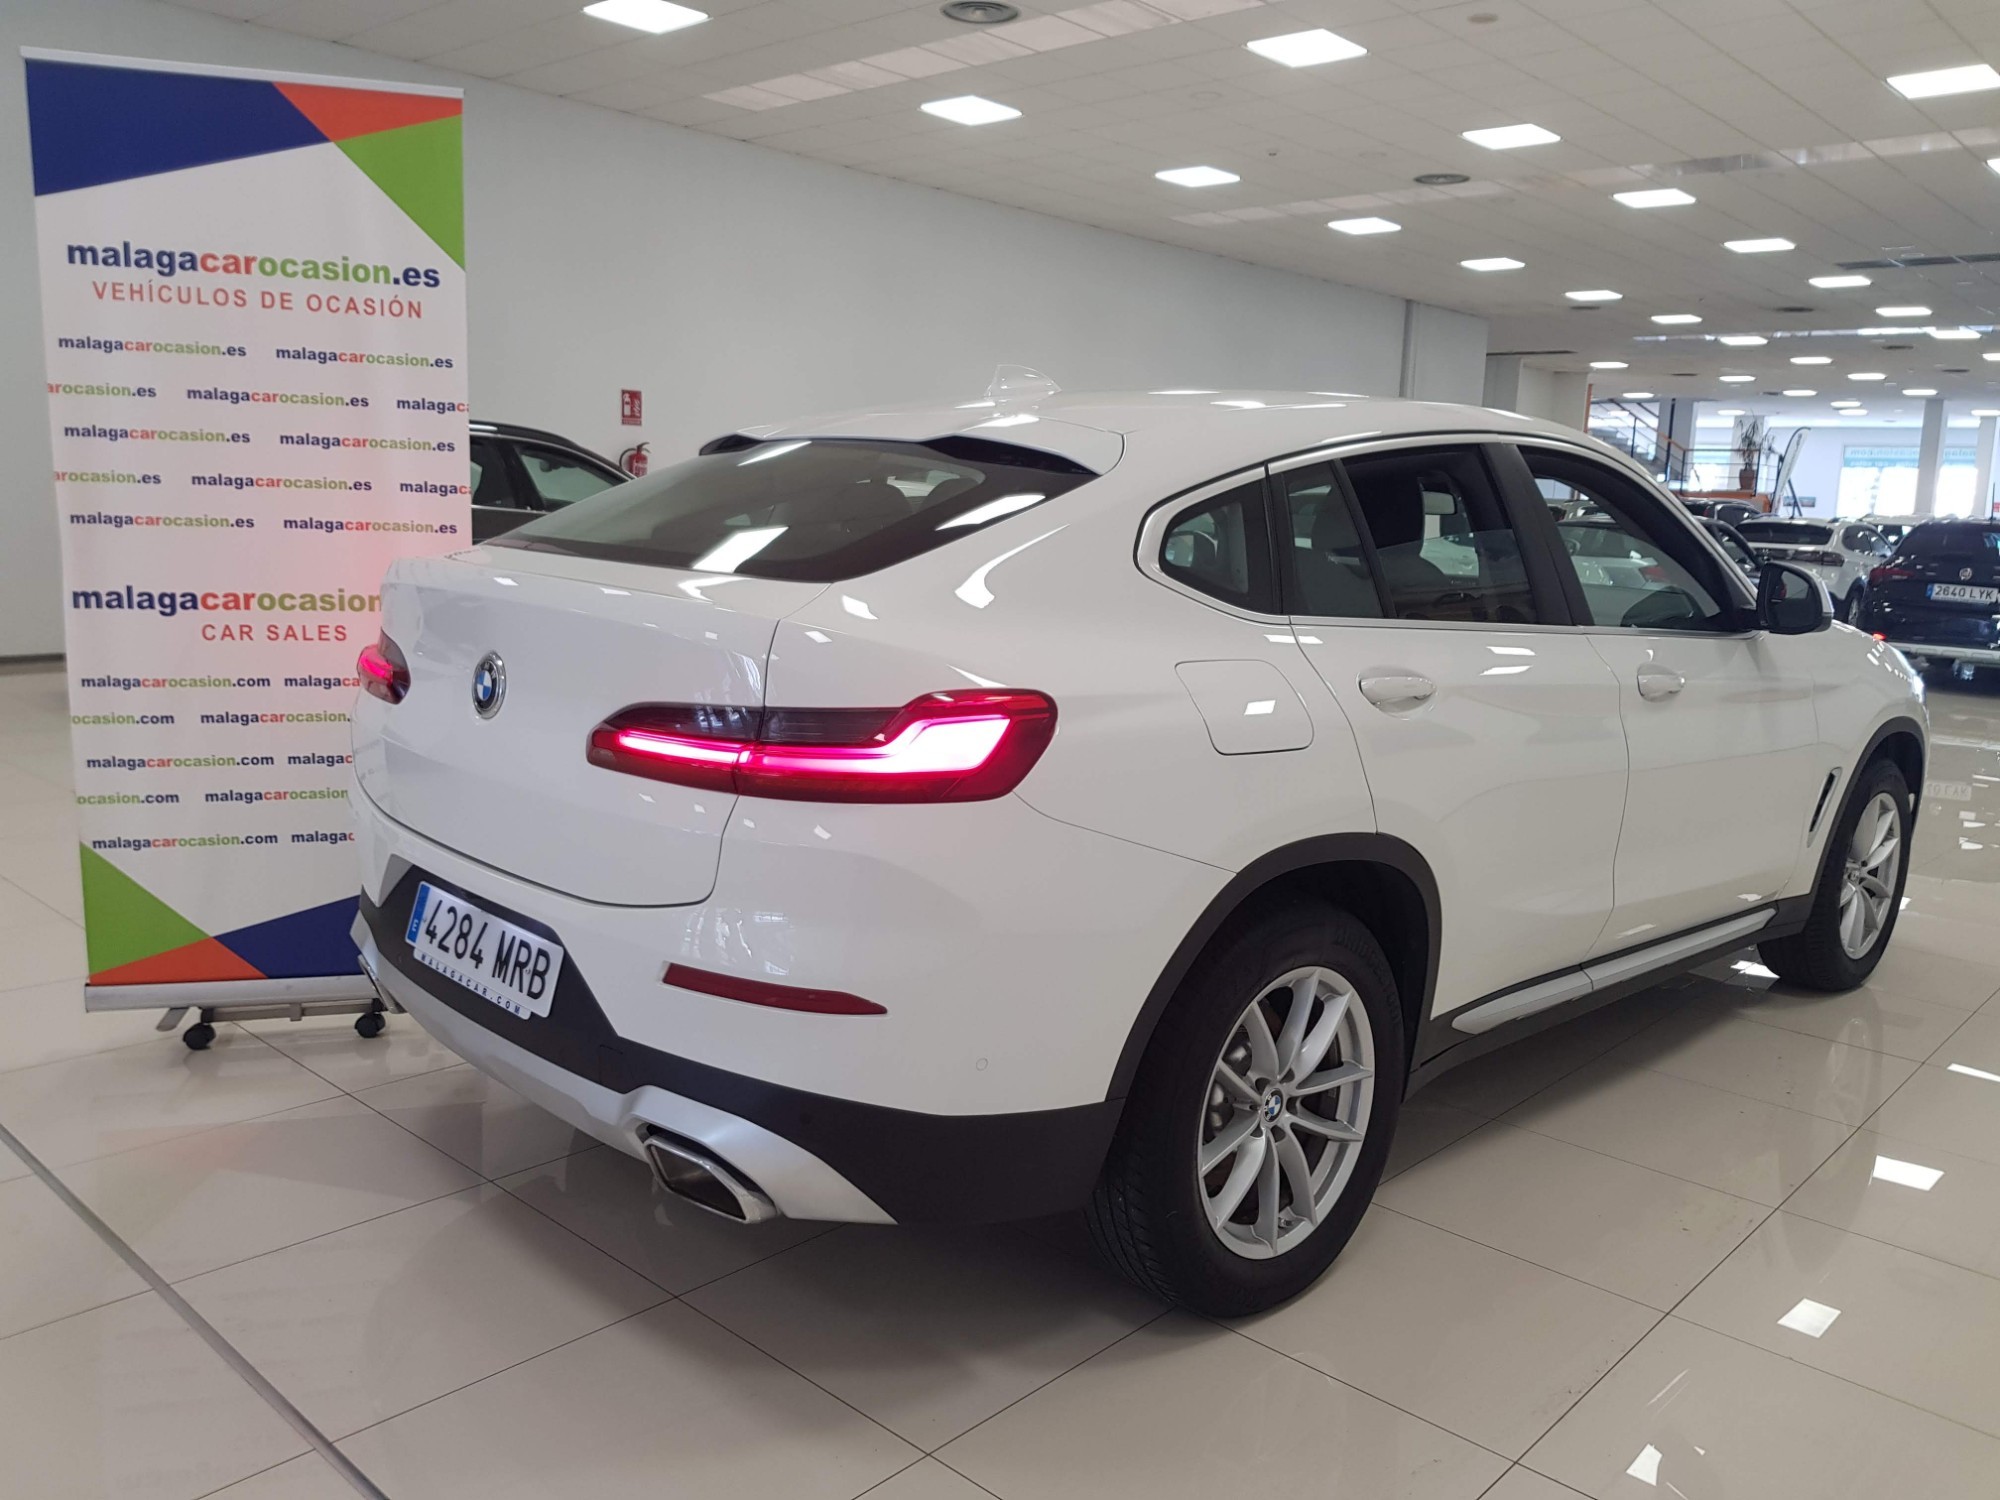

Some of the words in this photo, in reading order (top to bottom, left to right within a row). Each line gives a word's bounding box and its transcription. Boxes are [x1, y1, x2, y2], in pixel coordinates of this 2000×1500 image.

[67, 241, 440, 288] malagacarocasion.es
[93, 279, 247, 307] VEHÍCULOS
[261, 292, 293, 310] DE
[307, 295, 421, 318] OCASIÓN
[58, 336, 246, 356] malagacarocasion.es
[276, 347, 453, 368] malagacarocasion.es
[187, 387, 369, 407] malagacarocasion.es
[64, 425, 250, 443] malagacarocasion.es
[280, 433, 455, 452] malagacarocasion.es
[192, 473, 372, 491] malagacarocasion.es
[70, 512, 254, 528] malagacarocasion.es
[284, 517, 457, 534] malagacarocasion.es
[1935, 586, 1966, 597] 2640
[1970, 588, 1994, 600] LYK
[202, 624, 253, 641] CAR
[267, 624, 347, 641] SALES
[81, 675, 270, 690] malagacarocasion.com
[87, 755, 274, 771] malagacarocasion.com
[93, 834, 278, 850] malagacarocasion.com
[425, 899, 488, 969] 4284
[492, 930, 551, 1000] MRB
[420, 954, 521, 1015] MALAGACAR.COM
